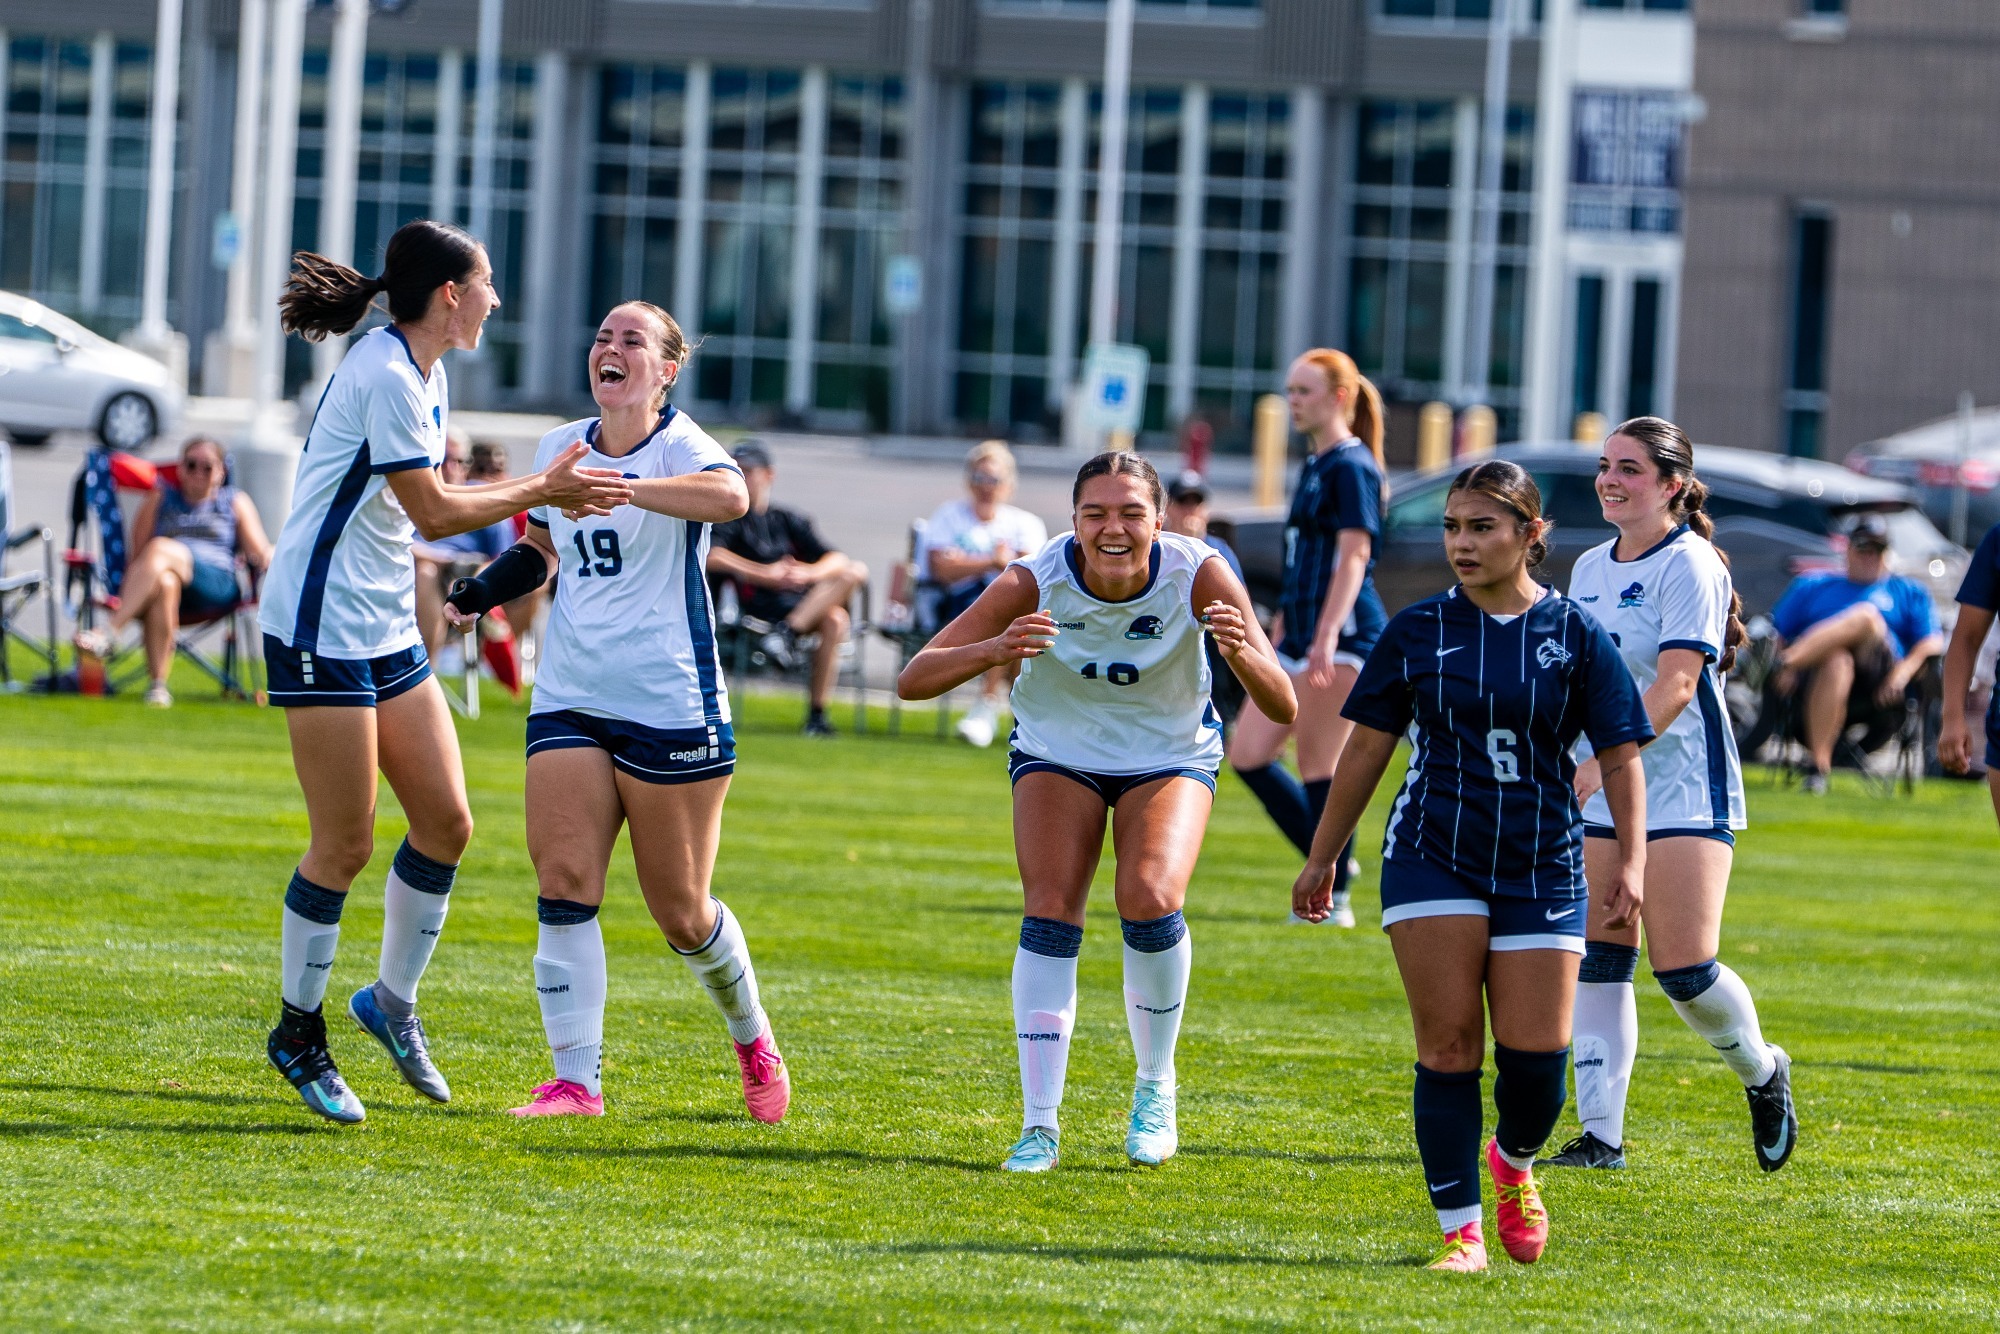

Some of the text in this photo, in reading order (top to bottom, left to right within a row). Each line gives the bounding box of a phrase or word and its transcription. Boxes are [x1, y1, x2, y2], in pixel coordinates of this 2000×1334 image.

[573, 529, 622, 577] 19
[669, 746, 707, 761] capelli
[1487, 729, 1521, 782] 6
